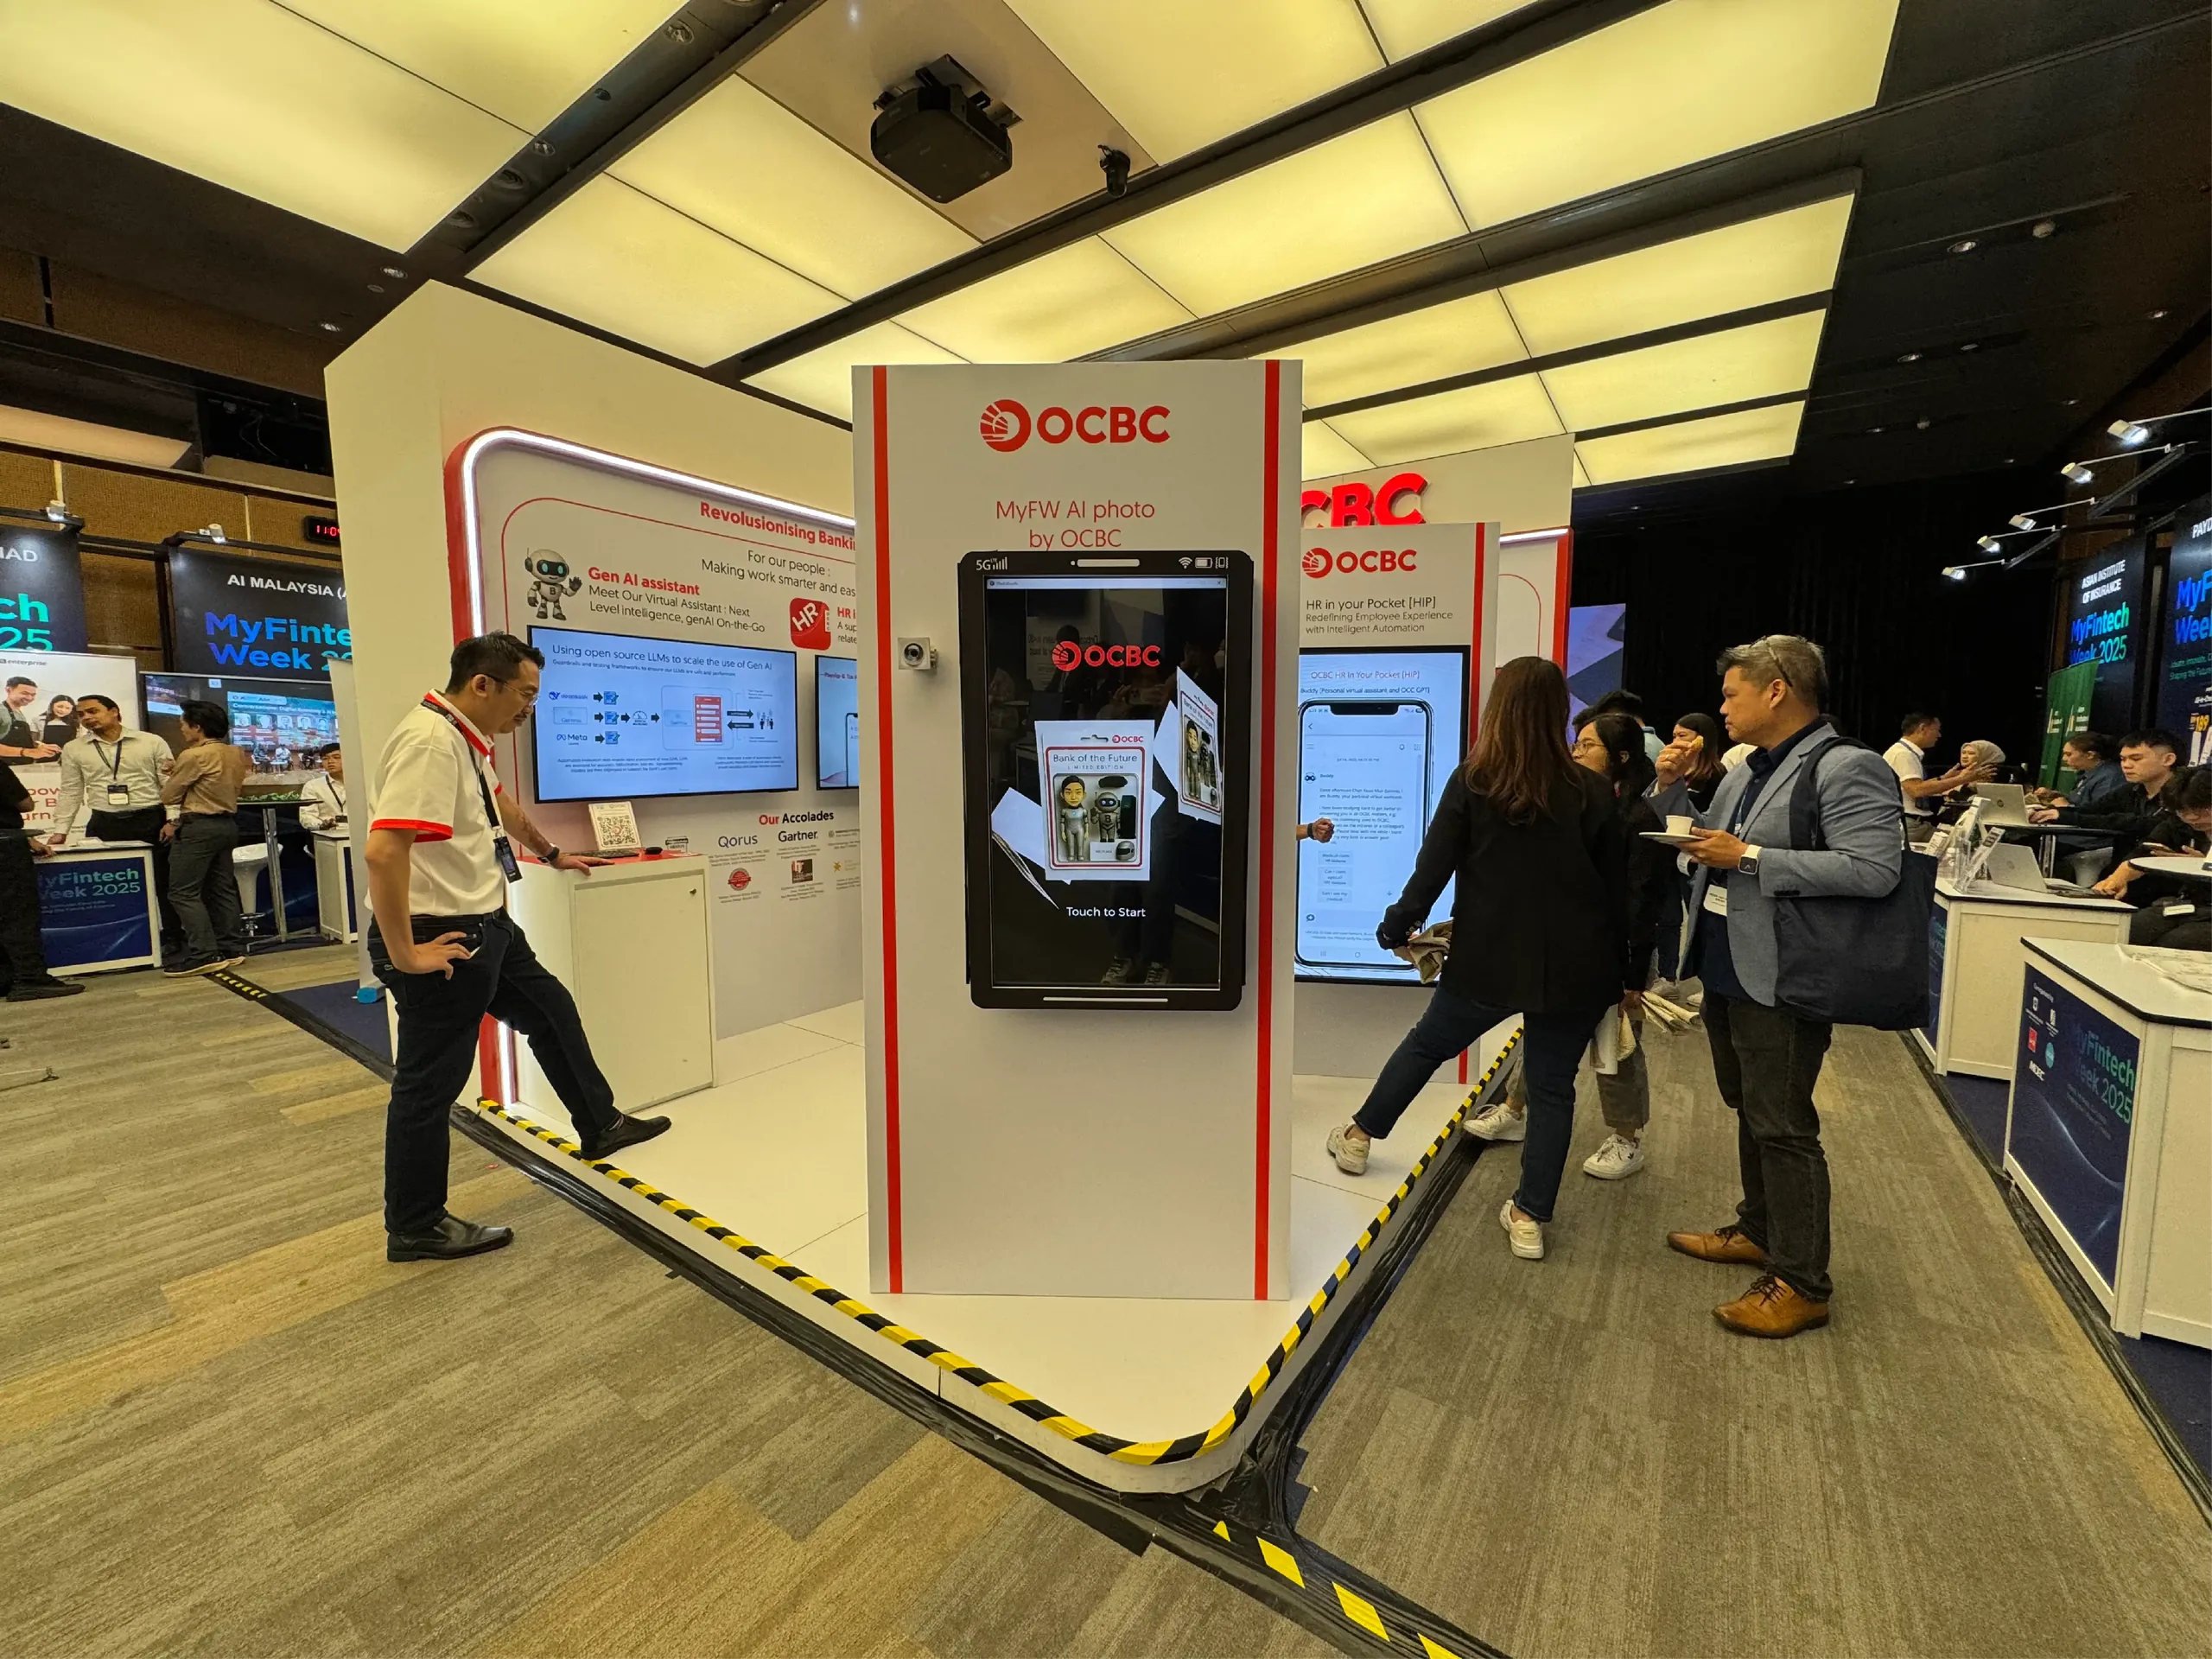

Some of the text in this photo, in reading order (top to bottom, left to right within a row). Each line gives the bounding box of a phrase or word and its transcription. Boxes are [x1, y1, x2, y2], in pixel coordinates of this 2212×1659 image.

[1037, 405, 1171, 444] OCBC
[700, 501, 816, 544] Revolusionising
[995, 499, 1155, 523] MyFW AI photo
[316, 524, 340, 537] 11:0
[1029, 529, 1122, 551] by OCBC
[747, 550, 766, 563] For
[768, 556, 786, 569] our
[789, 560, 825, 575] people
[976, 559, 991, 571] 5G
[1336, 549, 1417, 574] OCBC
[227, 574, 245, 588] AI
[250, 576, 334, 598] MALAYSIA
[588, 567, 700, 596] Gen AI assistant
[702, 558, 745, 580] Making
[747, 569, 776, 583] work
[779, 575, 817, 590] smarter
[819, 582, 837, 594] and
[589, 585, 620, 599] Meet
[622, 589, 642, 602] Our
[645, 593, 678, 607] Virtual
[680, 598, 721, 613] Assistant
[728, 605, 750, 617] Next
[837, 607, 851, 619] HR
[1306, 596, 1436, 612] HR in your Pocket [HIP]
[589, 601, 620, 615] Level
[621, 607, 684, 624] intelligence,
[716, 618, 766, 632] On-the-Go
[791, 602, 819, 632] HR
[837, 621, 843, 630] A
[1306, 610, 1453, 623] Redefining Employee Experience
[2070, 601, 2130, 645] MyFintech
[1306, 624, 1425, 635] with Intelligent Automation
[207, 642, 313, 671] Week
[552, 645, 582, 658] Using
[584, 648, 611, 658] open
[613, 651, 645, 661] source
[647, 652, 670, 663] LLMs
[671, 655, 681, 664] to
[683, 656, 704, 665] scale
[706, 658, 720, 667] the
[721, 659, 735, 668] use
[737, 659, 745, 669] of
[747, 660, 763, 670] Gen
[1084, 645, 1160, 667] OCBC
[2099, 634, 2127, 664] 2025
[1375, 671, 1400, 679] Pocket
[1053, 753, 1138, 762] Bank of the Future
[759, 810, 835, 826] Our Accolades
[718, 835, 759, 849] Qorus
[92, 881, 141, 897] 2025
[1066, 906, 1146, 918] Touch to Start
[2101, 1077, 2133, 1125] 2025
